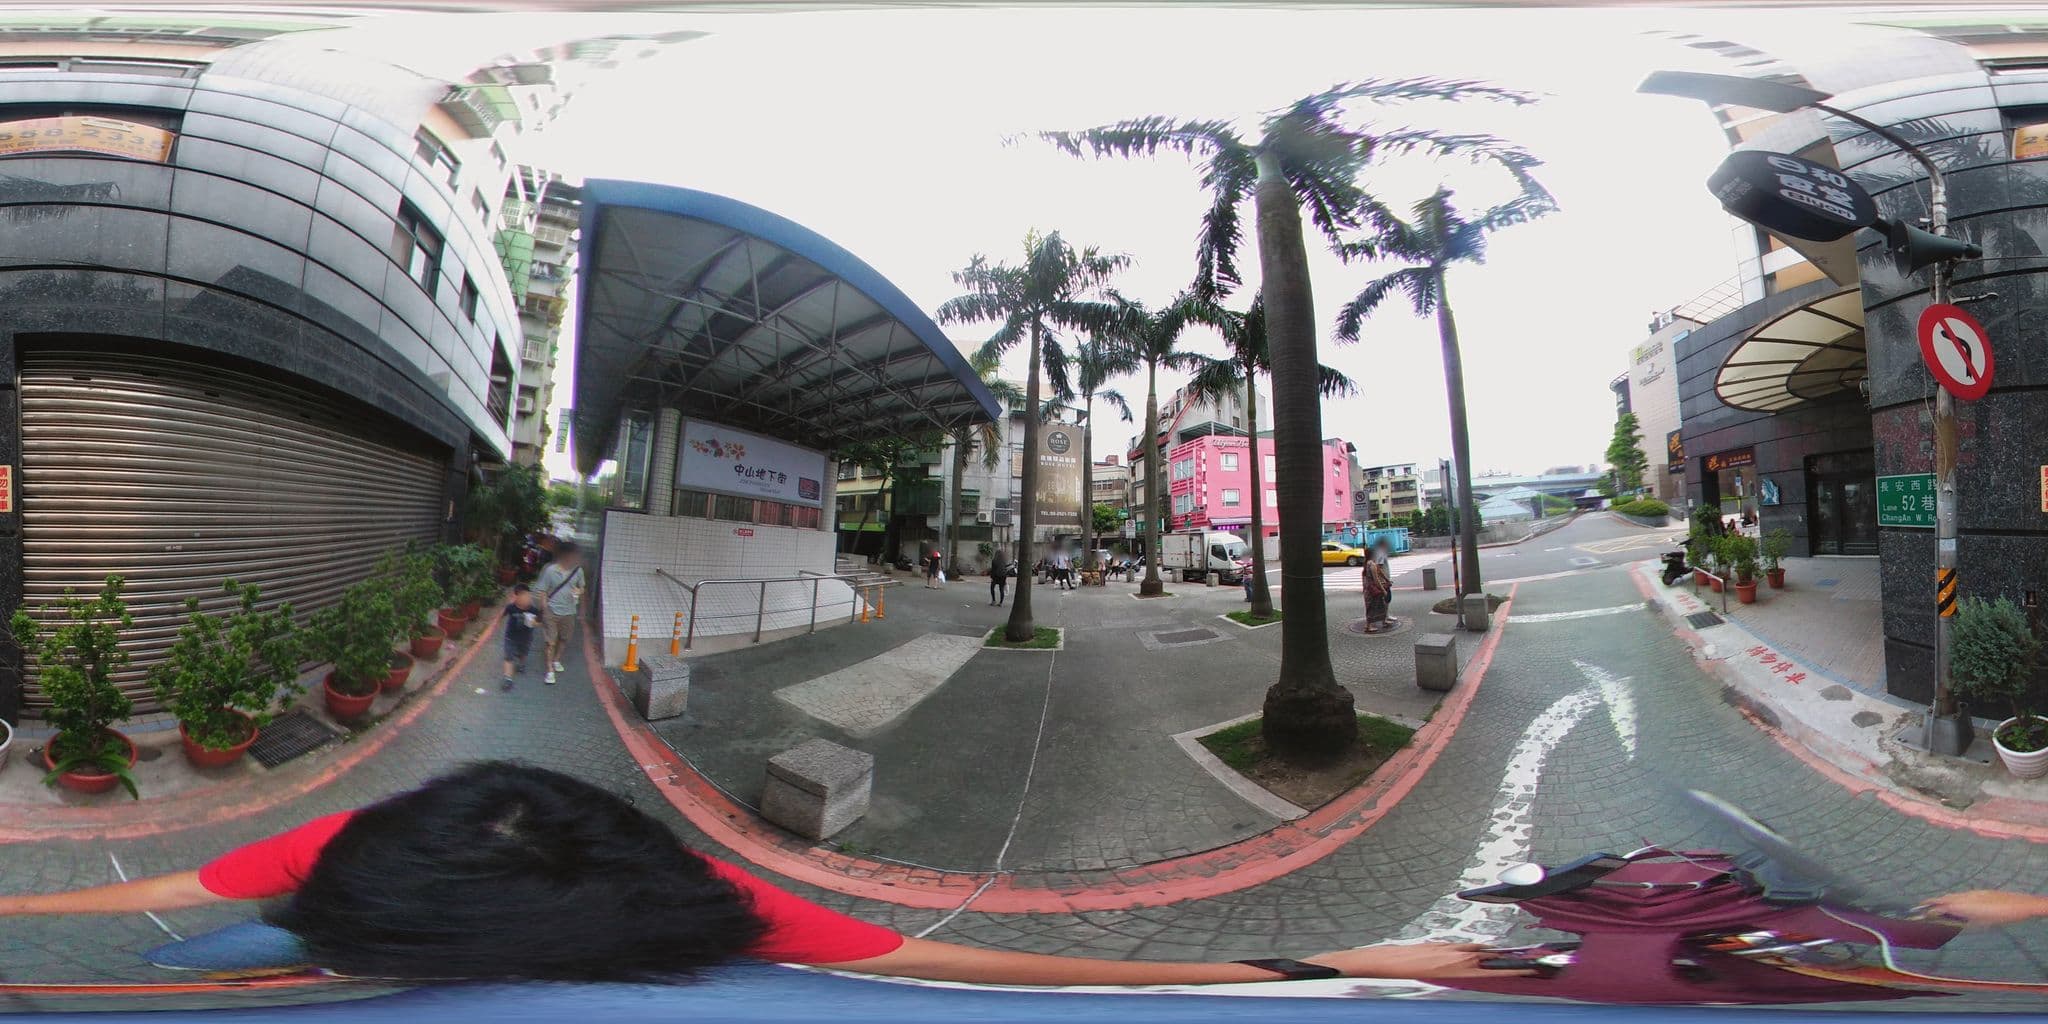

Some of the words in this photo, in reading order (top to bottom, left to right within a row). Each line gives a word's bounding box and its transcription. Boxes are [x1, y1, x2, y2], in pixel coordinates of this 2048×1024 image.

[734, 463, 787, 484] 中山地下街
[1902, 495, 1916, 511] 52
[1921, 494, 1935, 511] 巷
[1881, 513, 1911, 522] ChangAn
[1915, 513, 1922, 521] W
